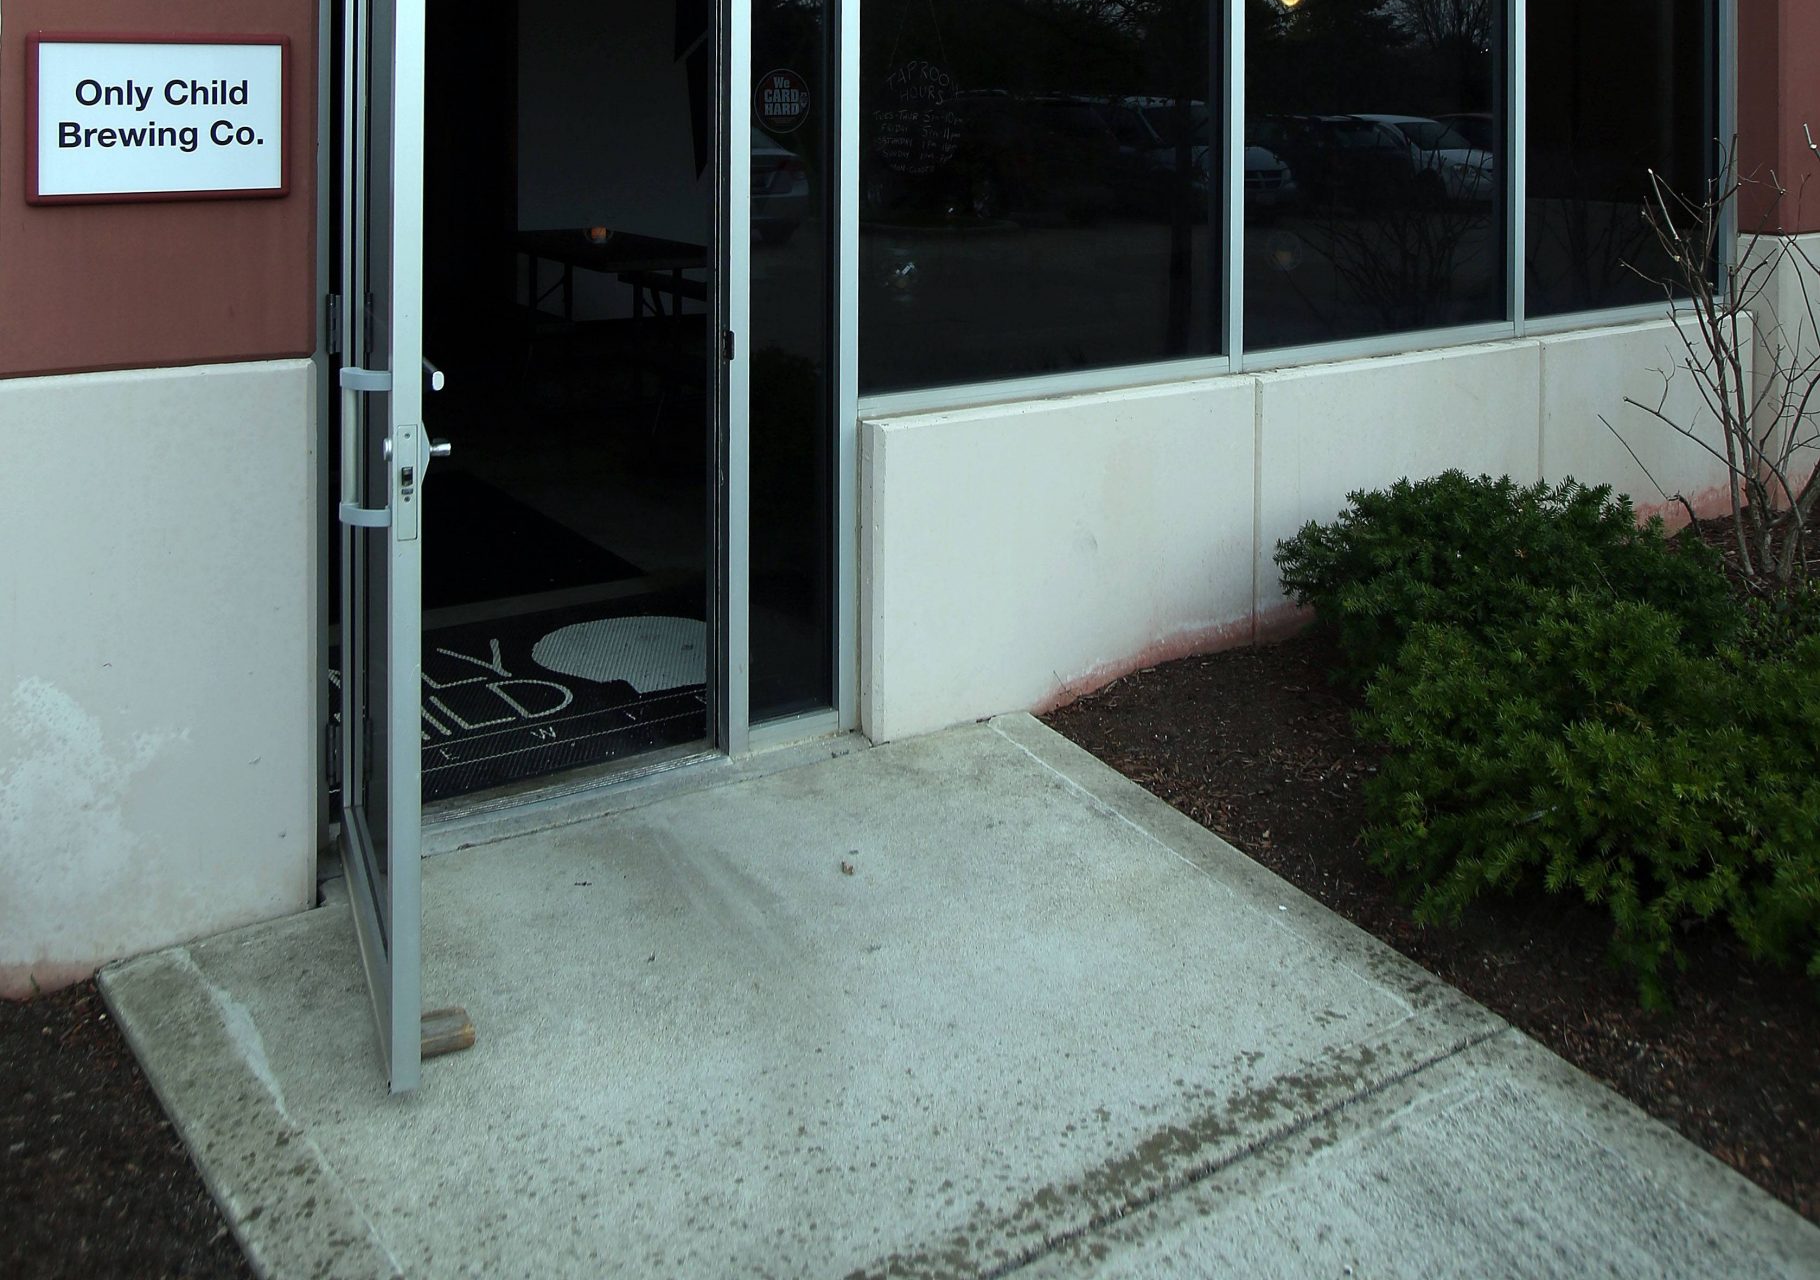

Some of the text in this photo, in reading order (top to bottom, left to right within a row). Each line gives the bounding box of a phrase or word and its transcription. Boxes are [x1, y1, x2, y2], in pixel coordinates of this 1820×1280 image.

[773, 76, 791, 89] We
[887, 60, 960, 101] TAPROOM
[75, 79, 249, 111] Only Child
[764, 89, 800, 102] CARD
[901, 85, 944, 105] HOURS
[764, 103, 800, 116] HARD
[58, 119, 264, 153] Brewing Co.
